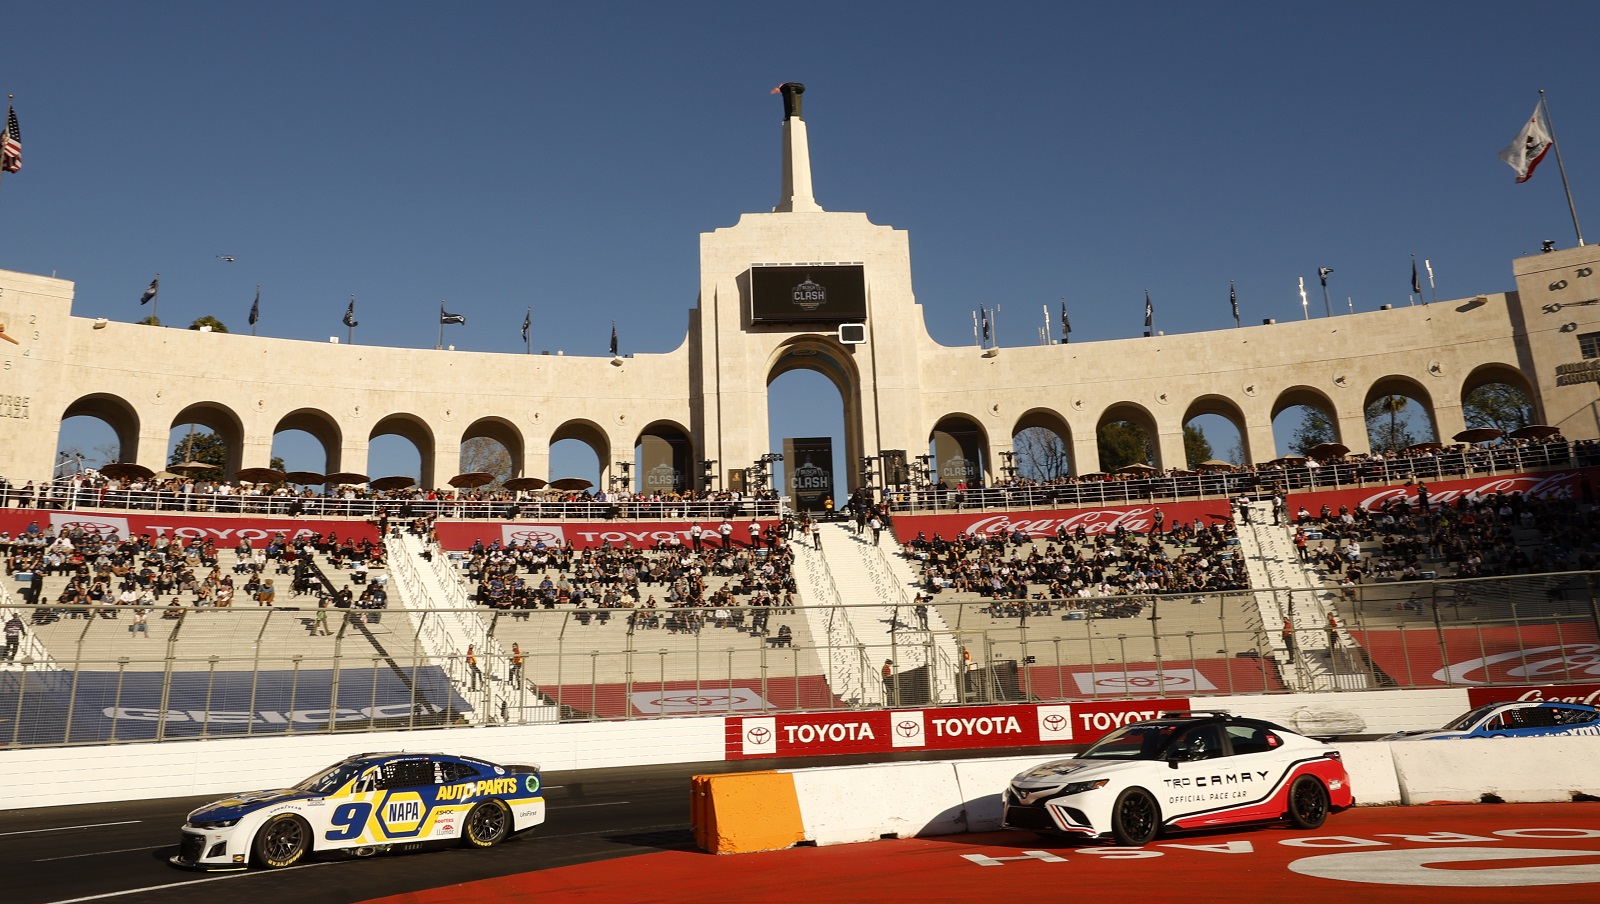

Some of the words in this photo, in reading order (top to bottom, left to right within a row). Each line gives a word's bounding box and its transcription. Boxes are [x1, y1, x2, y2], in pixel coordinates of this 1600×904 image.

[1575, 267, 1593, 278] 70
[1549, 280, 1568, 291] 60
[794, 291, 825, 300] CLASH
[1542, 303, 1562, 314] 50
[29, 314, 37, 325] 2
[32, 330, 40, 340] 3
[23, 349, 30, 357] 4
[4, 360, 12, 370] 5
[944, 466, 975, 477] CLASH
[648, 474, 679, 485] CLASH
[791, 476, 828, 489] CLASH
[965, 505, 1154, 536] Coca-Cola
[577, 530, 724, 542] TOYOTA
[102, 704, 442, 724] GEICO
[931, 716, 1022, 737] TOYOTA
[1079, 711, 1166, 731] TOYOT
[784, 723, 875, 744] TOYOTA
[1196, 770, 1269, 787] CAMRY
[435, 782, 477, 801] AUTO
[476, 778, 517, 797] PARTS
[1168, 794, 1206, 804] OFFICIAL
[1209, 792, 1229, 800] PACE
[1232, 790, 1248, 798] CAR
[389, 802, 419, 822] NAPA
[325, 802, 373, 841] 9
